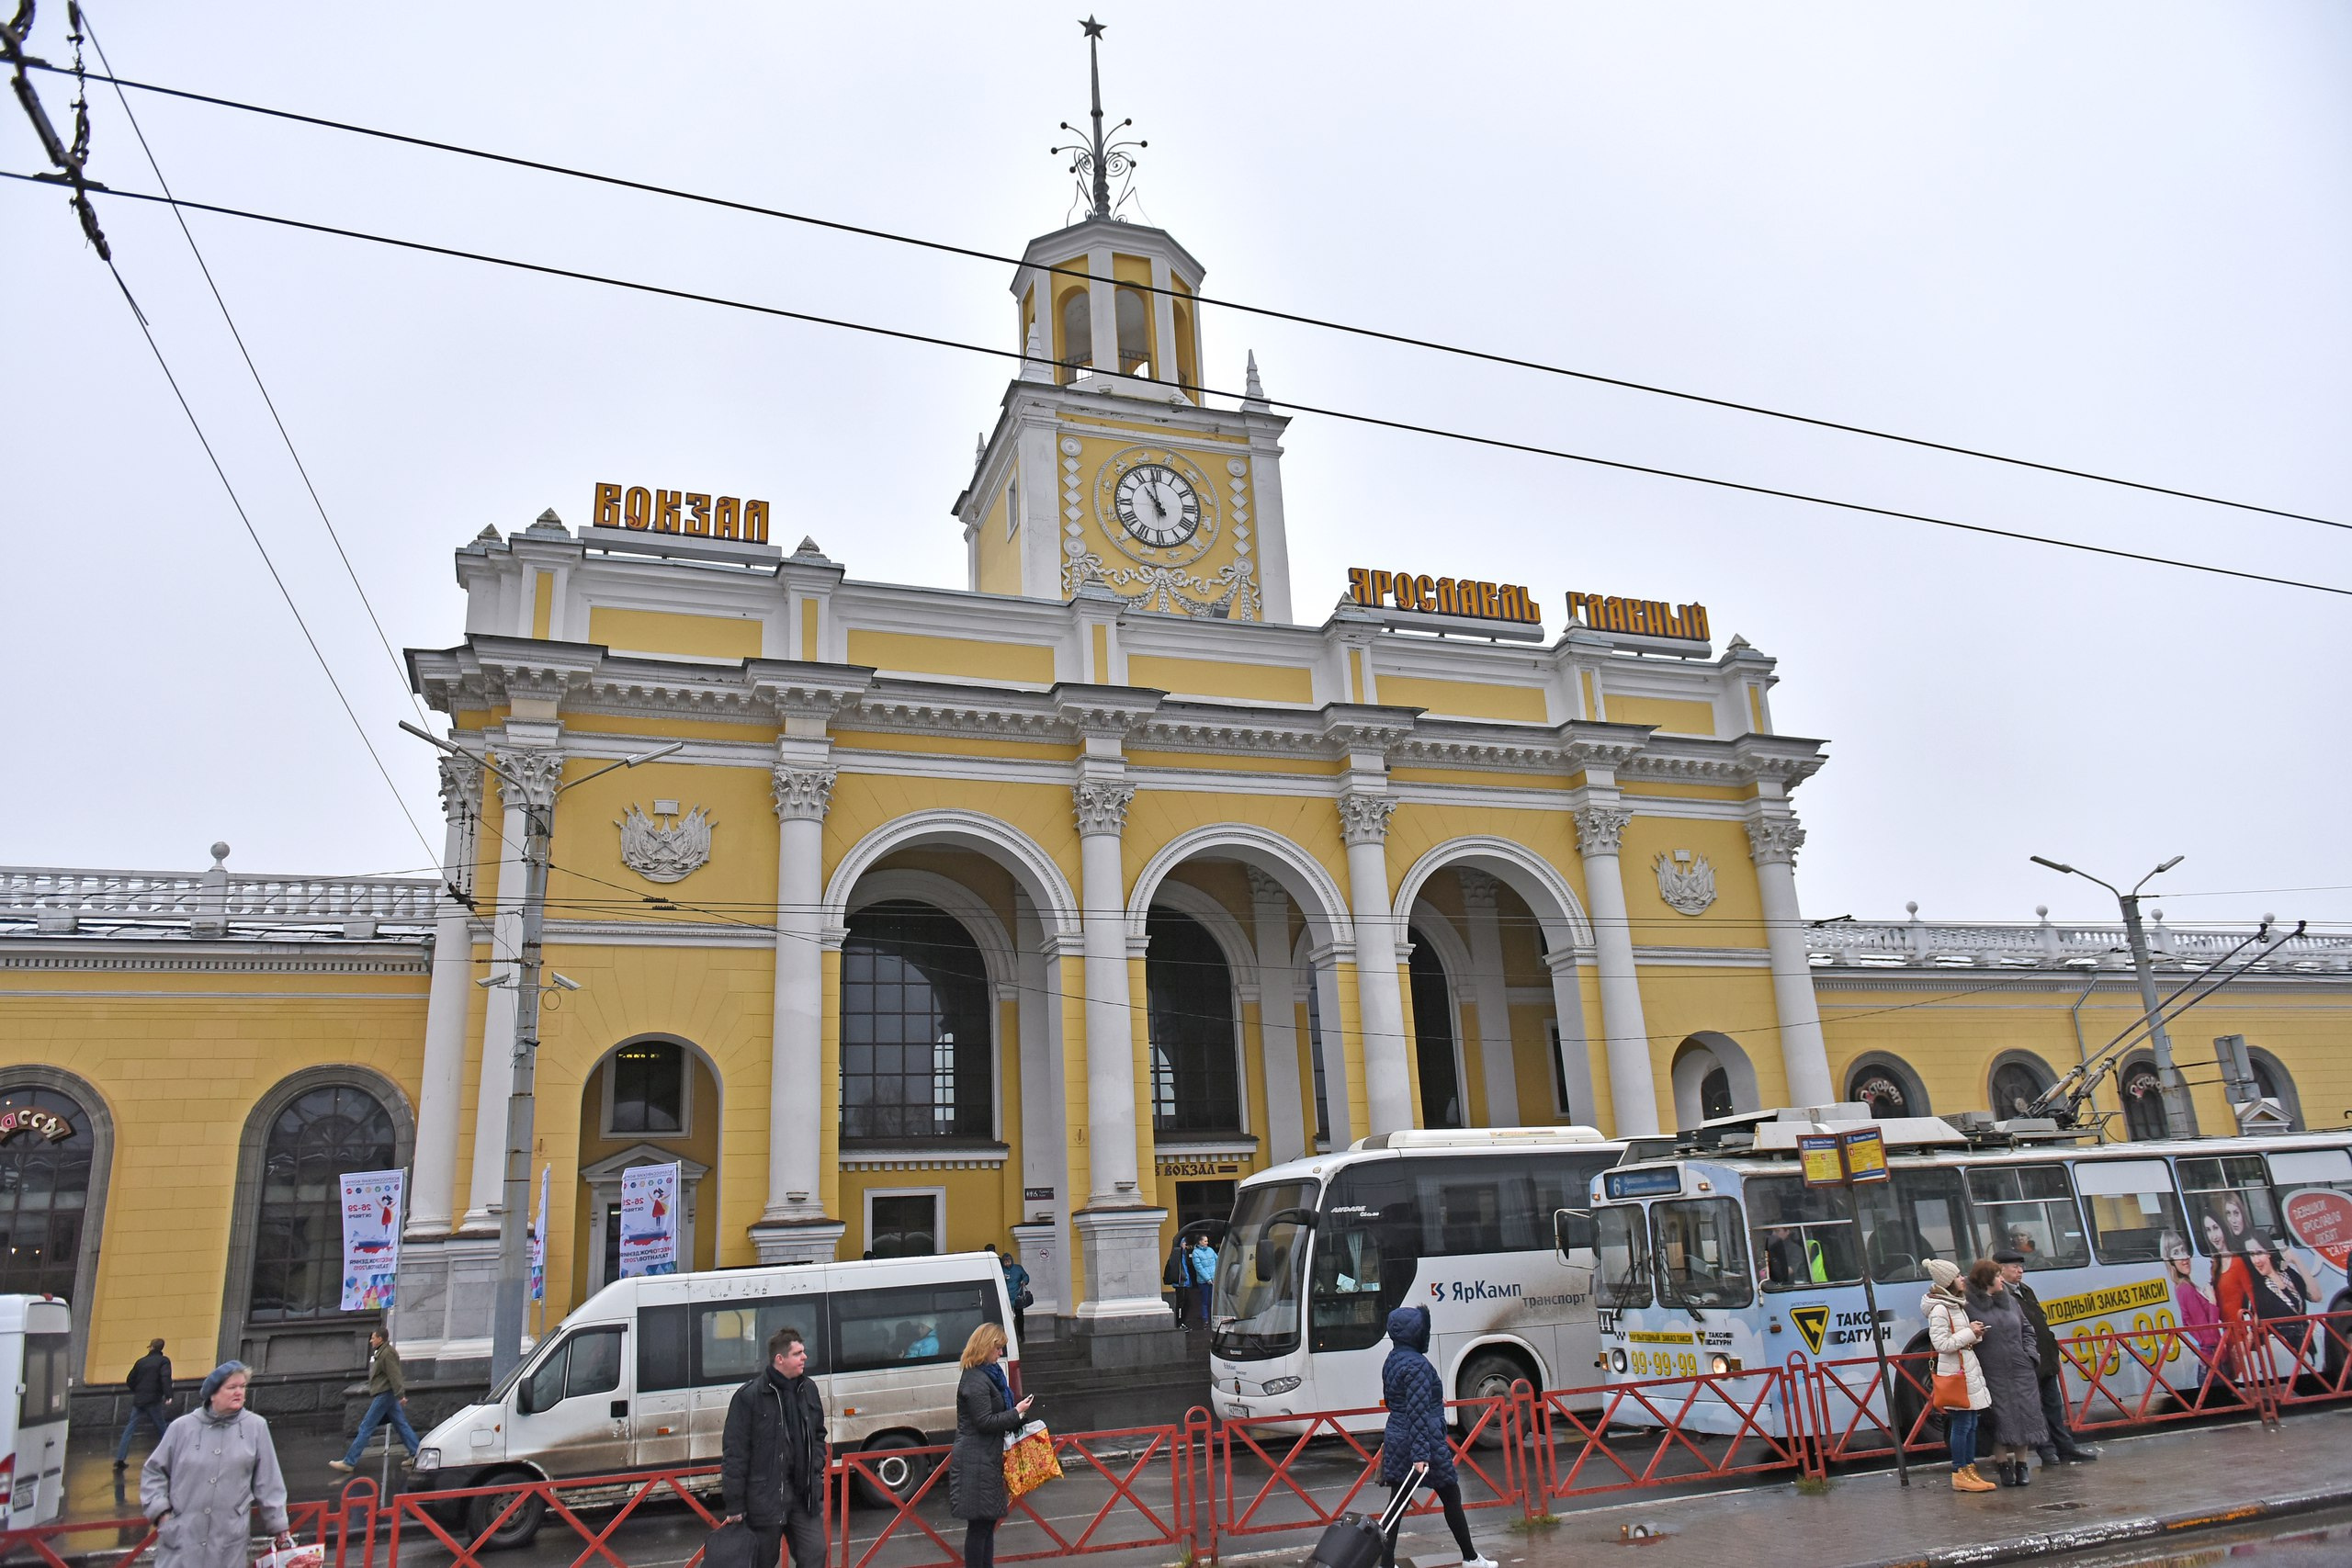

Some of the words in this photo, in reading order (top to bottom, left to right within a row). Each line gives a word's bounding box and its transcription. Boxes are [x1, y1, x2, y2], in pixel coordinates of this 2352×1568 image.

[593, 482, 770, 545] ВОКЗАЛ
[1348, 567, 1542, 625] ЯРОСЛАВЛЬ
[1566, 592, 1711, 642] ГЛАВНЫЙ
[0, 1109, 66, 1139] ассы
[1164, 1164, 1216, 1177] ВОКЗАЛ
[1613, 1178, 1621, 1196] 6
[1452, 1280, 1522, 1303] ЯрКамп
[1522, 1292, 1587, 1309] транспорт
[2043, 1292, 2097, 1320] ЫГОДНЫЙ
[2097, 1289, 2132, 1310] ЗАКАЗ
[2132, 1281, 2166, 1303] ТАКСИ
[1600, 1314, 1611, 1331] 44
[1836, 1311, 1872, 1327] ТАКС
[1838, 1326, 1892, 1345] САТУН
